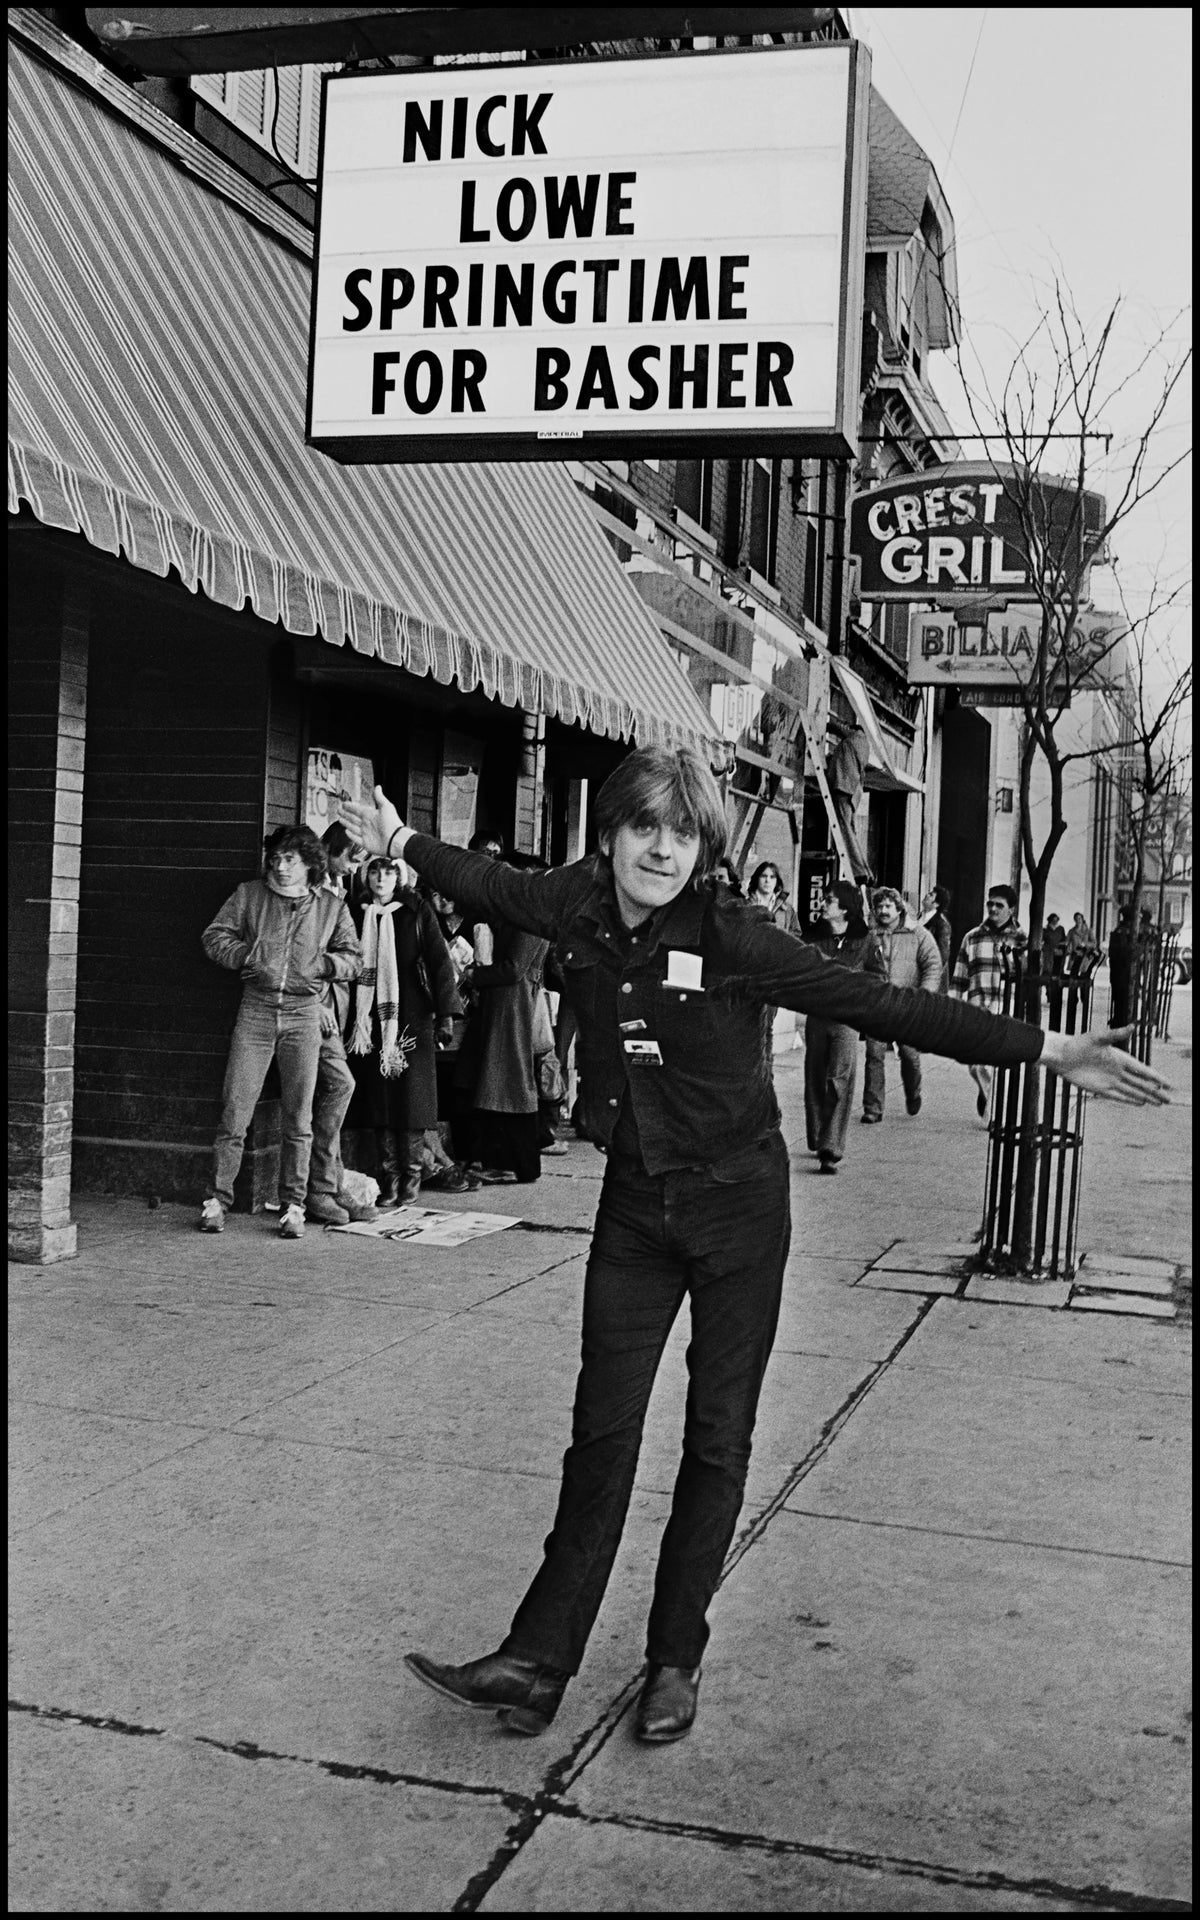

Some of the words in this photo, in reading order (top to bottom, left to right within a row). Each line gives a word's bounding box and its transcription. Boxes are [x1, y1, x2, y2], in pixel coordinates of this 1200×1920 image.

[402, 93, 554, 163] NICK
[459, 171, 637, 243] LOWE
[342, 255, 750, 332] SPRINGTIME
[371, 348, 488, 415] FOR
[534, 341, 795, 411] BASHER
[867, 483, 1004, 541] CREST
